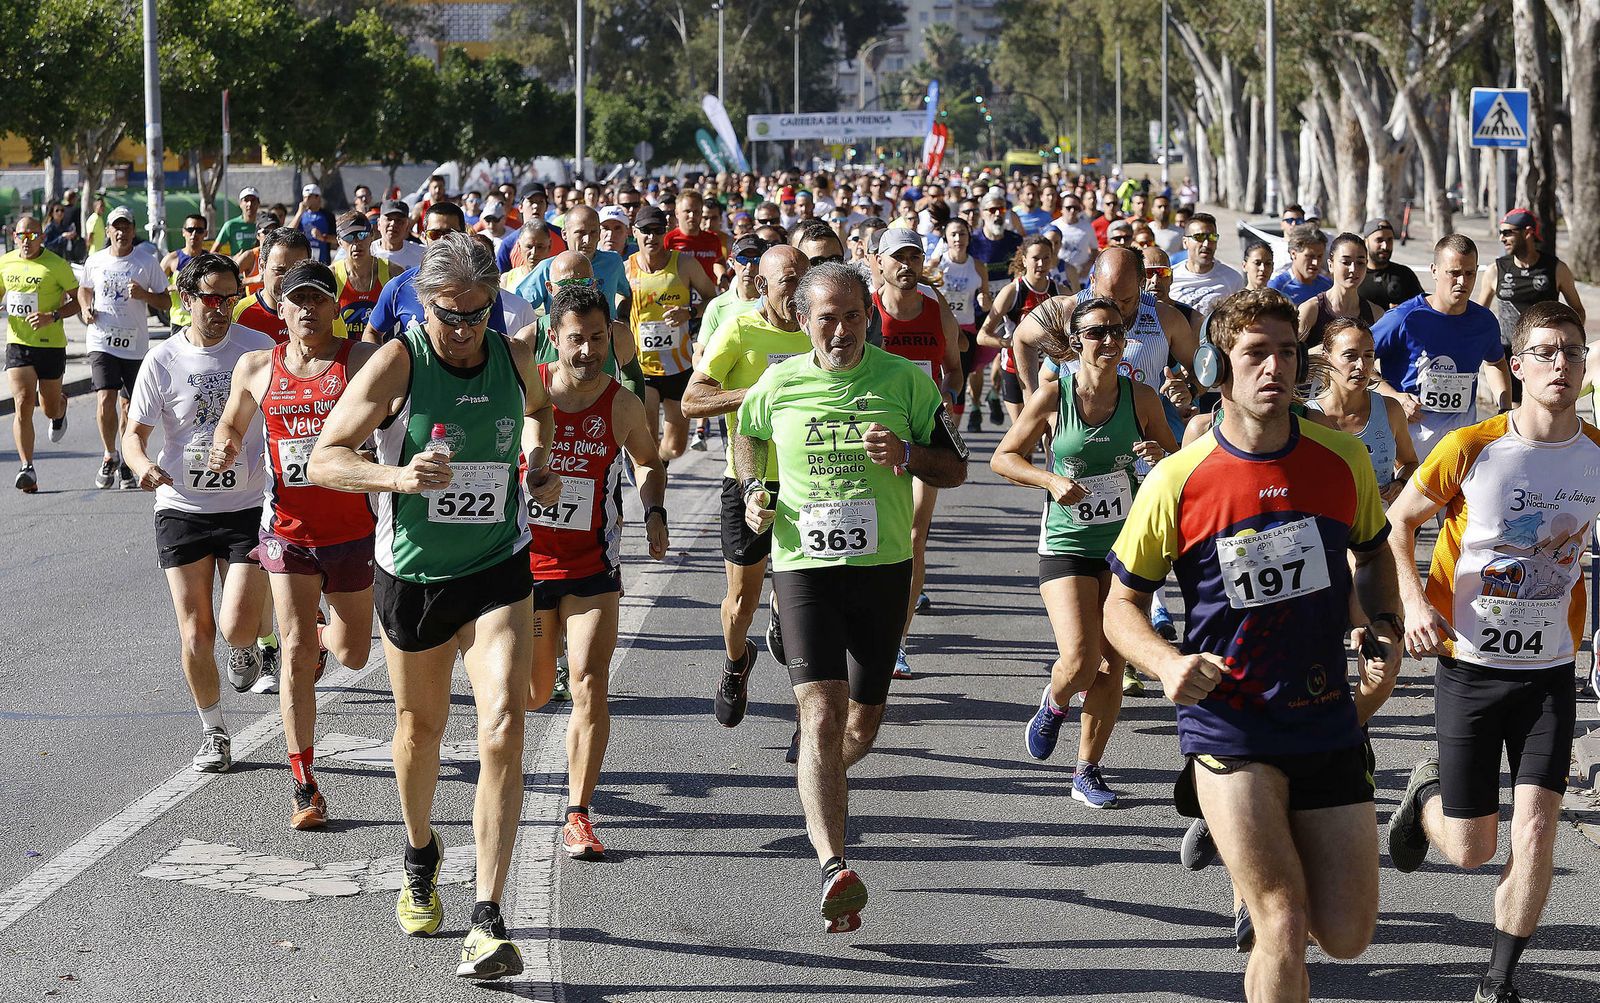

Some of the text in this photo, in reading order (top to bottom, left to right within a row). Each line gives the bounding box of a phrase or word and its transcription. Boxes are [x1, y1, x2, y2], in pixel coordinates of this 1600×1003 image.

[780, 115, 892, 127] CARRERA DE LA PRENSA
[10, 304, 32, 314] 760
[105, 336, 130, 348] 180
[644, 335, 673, 348] 624
[1425, 391, 1462, 408] 598
[269, 403, 310, 416] CLÍNICAS
[807, 451, 865, 465] De Oficio
[810, 463, 865, 476] Abogado
[189, 469, 237, 488] 728
[1510, 488, 1525, 512] 3
[1527, 491, 1543, 500] Trail
[1554, 488, 1596, 504] La Jábega
[436, 492, 495, 517] 522
[527, 498, 579, 523] 647
[1078, 496, 1123, 521] 841
[807, 527, 868, 552] 363
[1263, 532, 1273, 541] DE
[1274, 529, 1283, 538] LA
[1283, 522, 1310, 535] PRENSA
[1234, 558, 1306, 601] 197
[1488, 598, 1518, 607] CARRERA
[1479, 627, 1544, 655] 204
